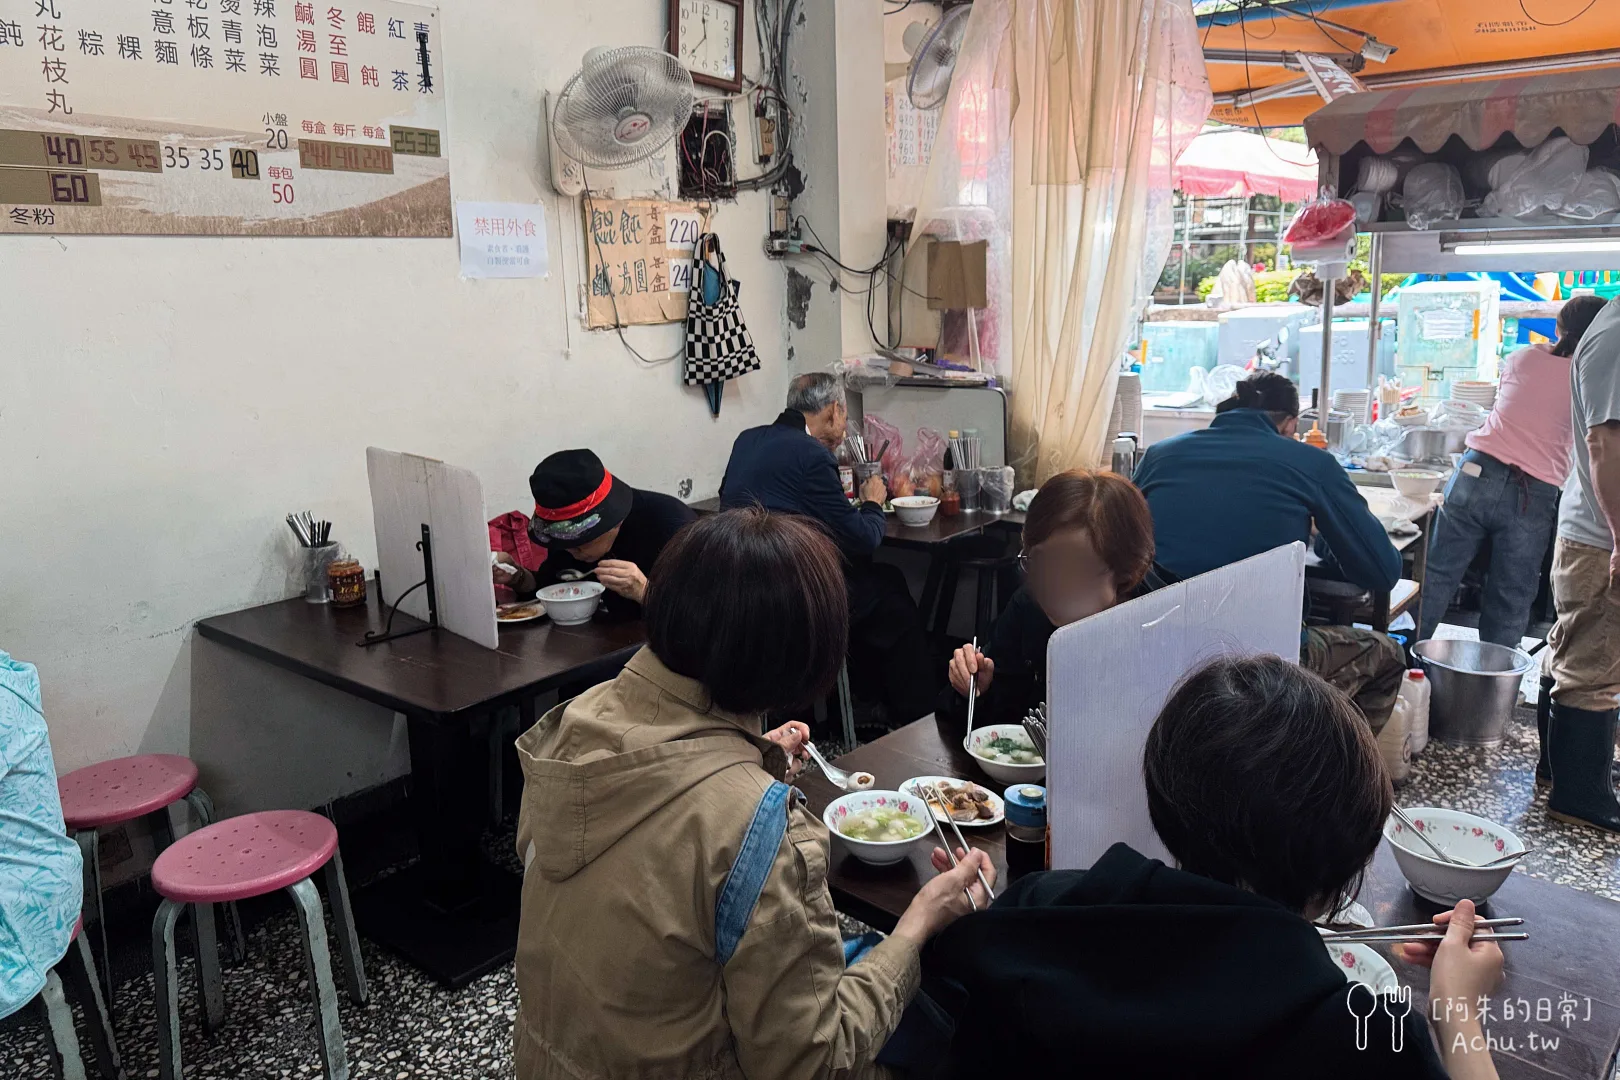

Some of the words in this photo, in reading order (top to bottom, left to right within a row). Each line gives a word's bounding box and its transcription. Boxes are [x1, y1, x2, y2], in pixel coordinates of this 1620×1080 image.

[681, 8, 689, 20] 10
[151, 0, 179, 65] 意麵
[680, 25, 686, 36] 9
[723, 20, 729, 31] 2
[78, 29, 105, 56] 粽
[116, 33, 142, 60] 粿
[253, 0, 280, 76] 辣泡菜
[294, 1, 319, 81] 鹹湯圓
[327, 6, 350, 85] 冬至圓
[681, 43, 687, 55] 8
[724, 37, 729, 48] 3
[702, 61, 708, 69] 6
[713, 61, 719, 71] 5
[262, 112, 288, 126] 小盤
[301, 120, 326, 134] 每盒
[333, 122, 356, 137] 每斤
[363, 125, 385, 139] 每盒
[265, 128, 288, 149] 20
[393, 130, 416, 153] 25
[47, 136, 82, 165] 40
[89, 140, 119, 164] 55
[127, 143, 158, 169] 45
[164, 146, 190, 169] 35
[200, 148, 224, 171] 35
[363, 148, 392, 171] 220
[232, 149, 259, 177] 40
[268, 166, 294, 179] 每包
[51, 173, 89, 202] 60
[272, 183, 295, 204] 50
[10, 208, 55, 225] 冬粉
[474, 217, 537, 237] 禁用外食
[670, 218, 699, 244] 220
